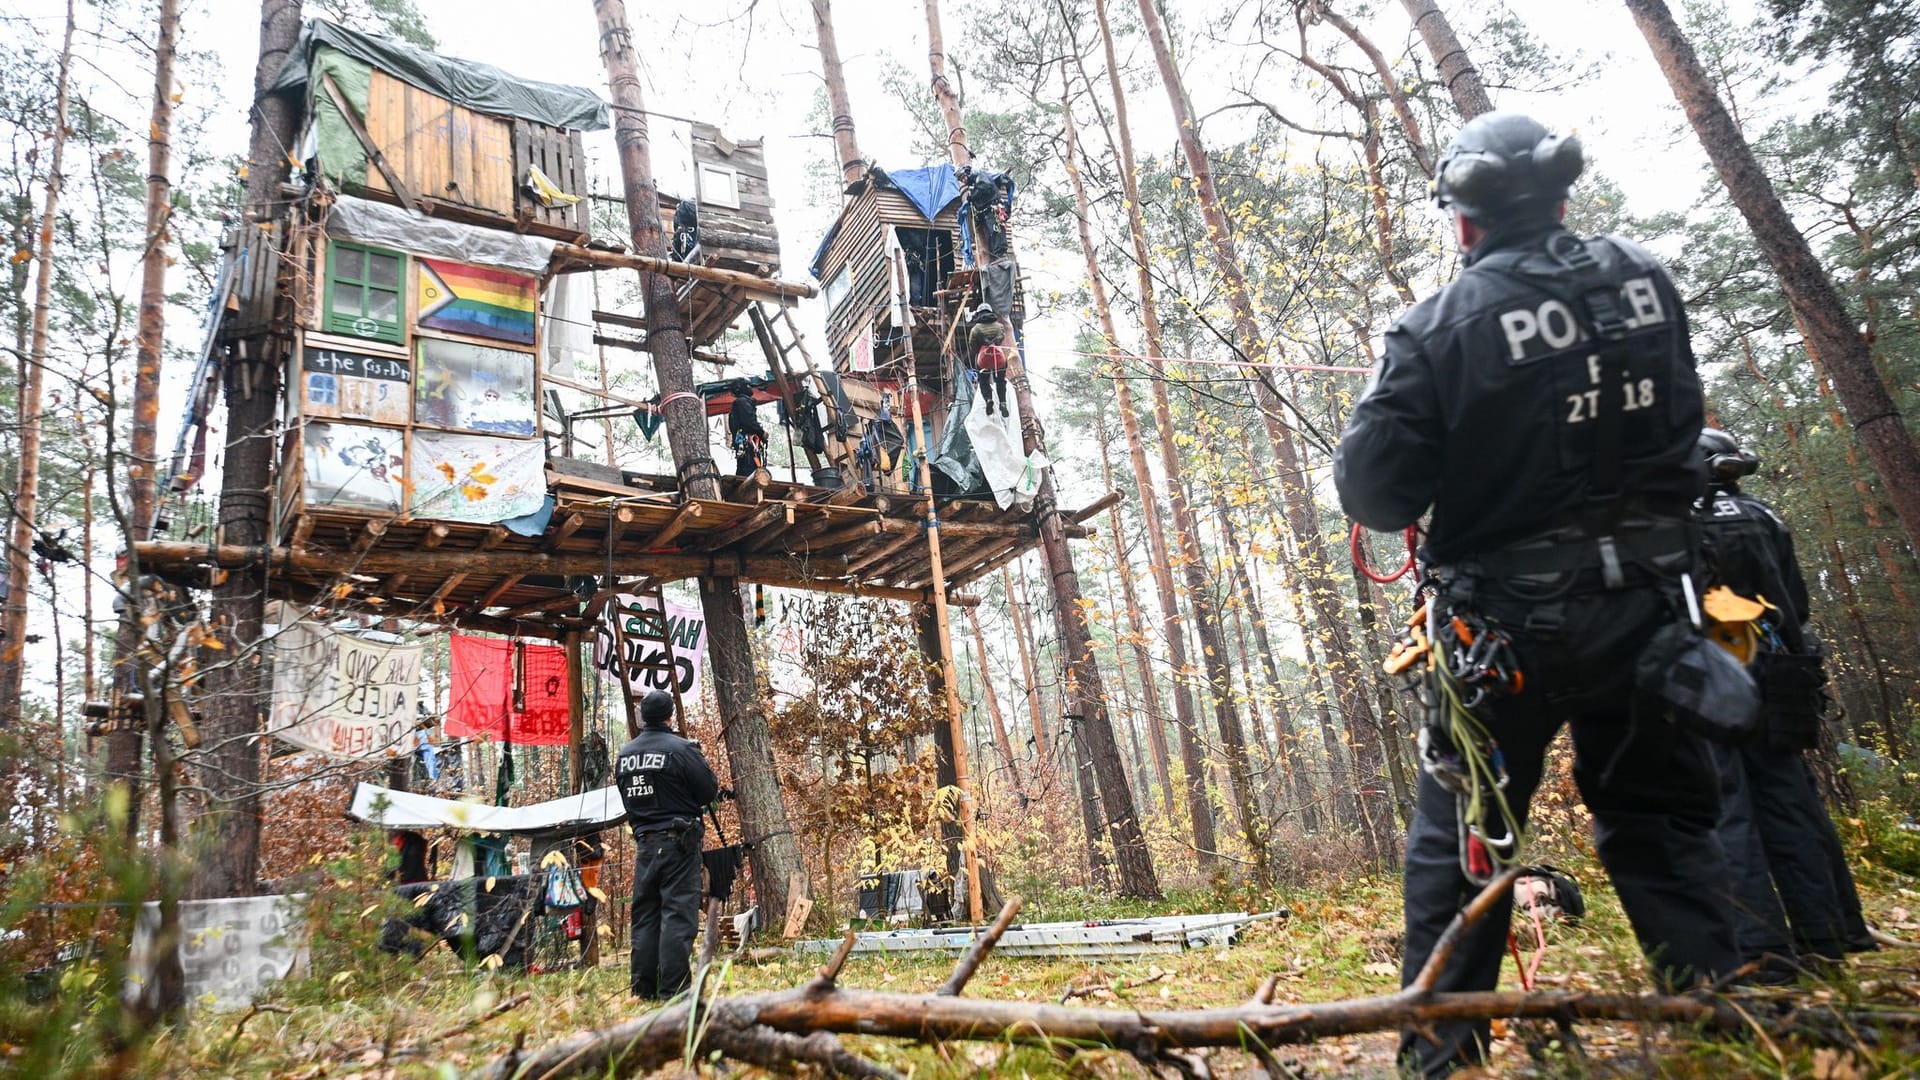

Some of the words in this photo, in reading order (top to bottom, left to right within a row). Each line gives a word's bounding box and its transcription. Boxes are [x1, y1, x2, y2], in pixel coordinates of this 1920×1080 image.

[1499, 277, 1666, 360] POEI
[316, 351, 355, 369] the
[1566, 378, 1655, 424] 2T18
[620, 753, 666, 773] POLIZEI
[632, 775, 646, 786] BE
